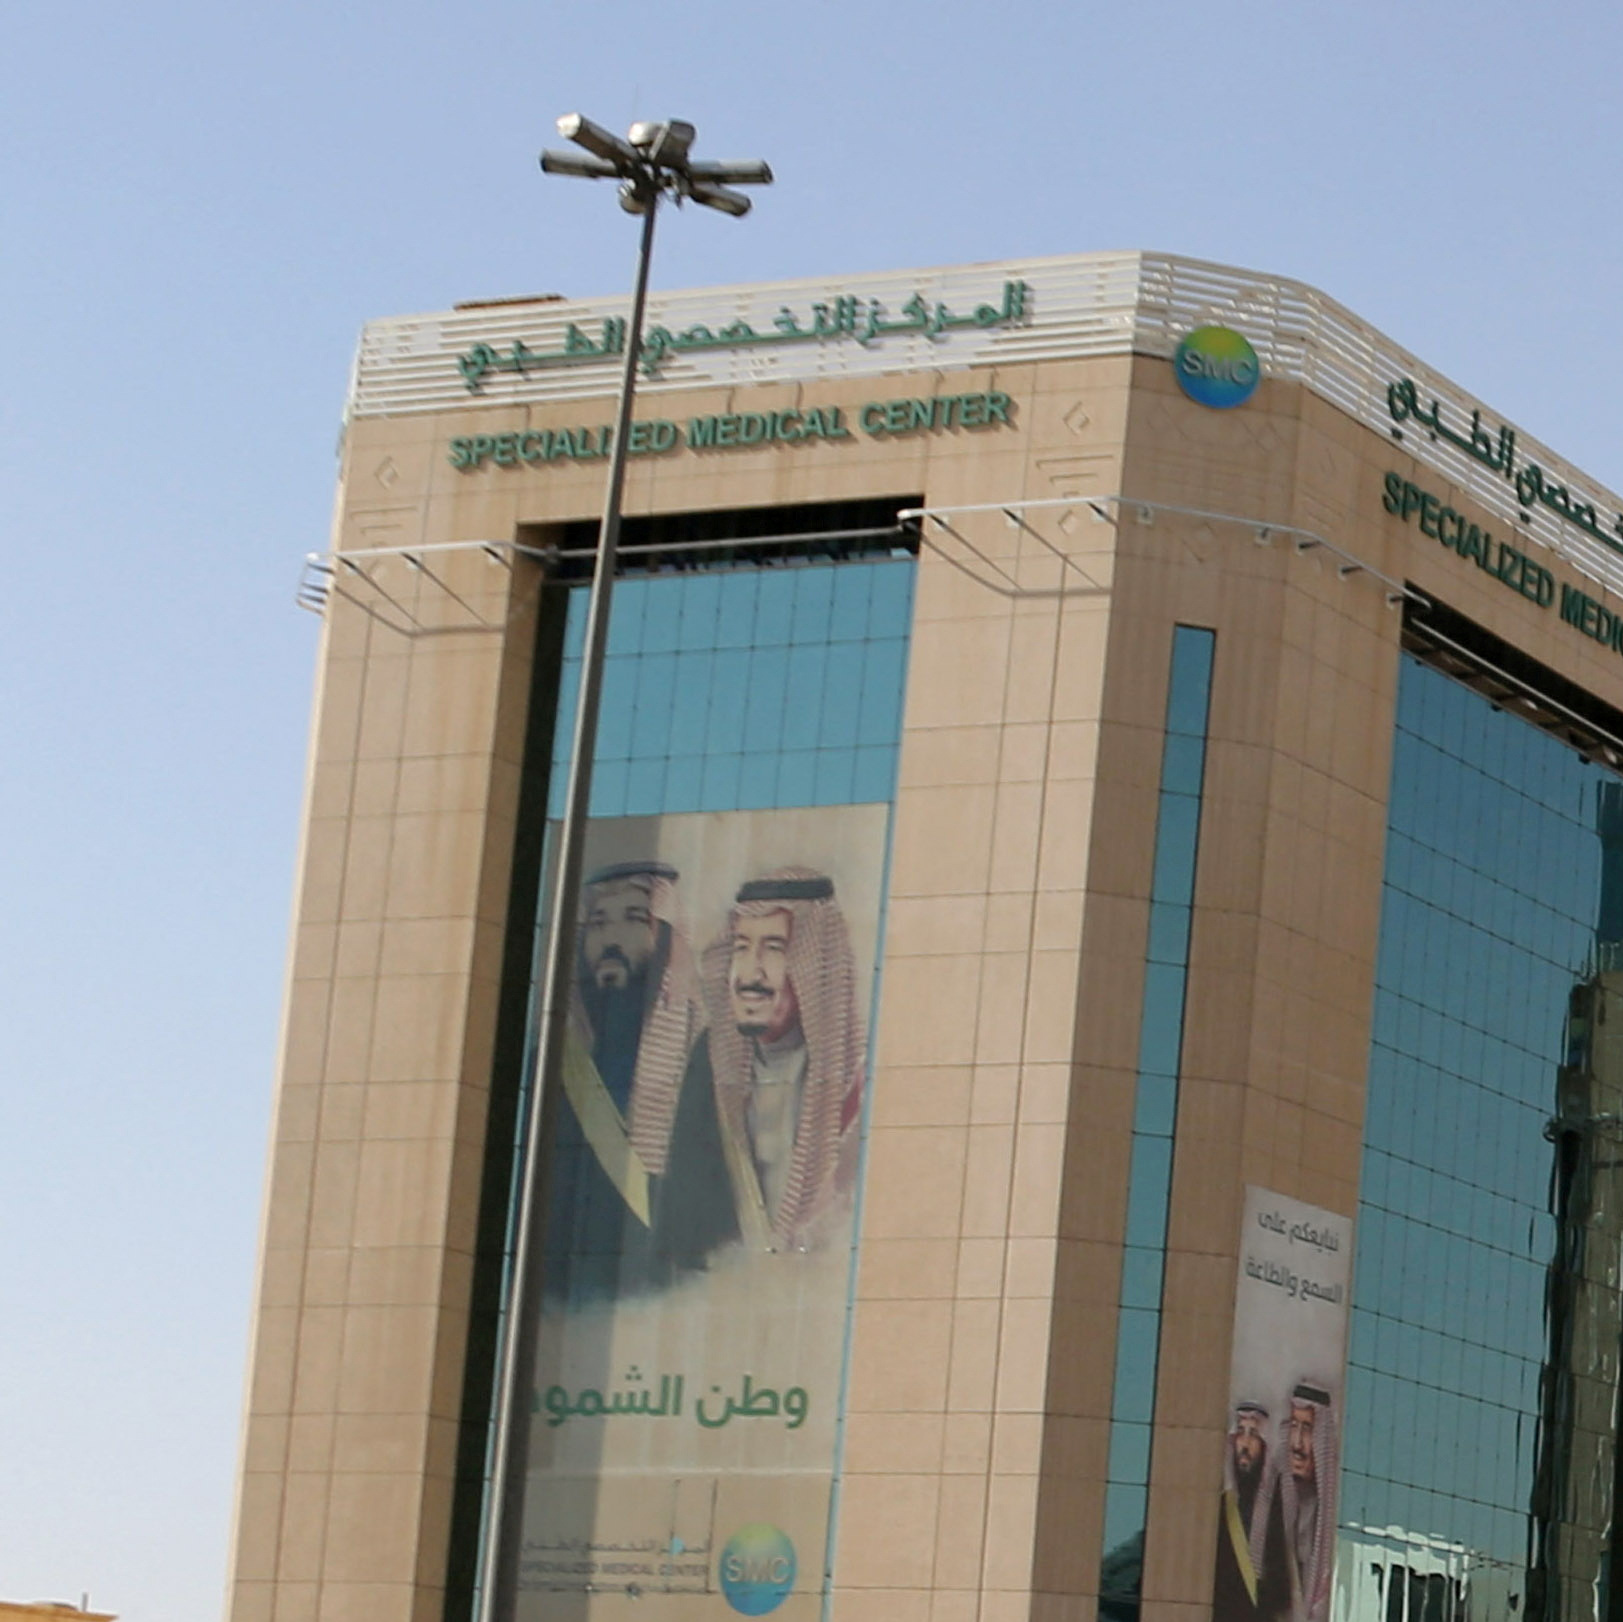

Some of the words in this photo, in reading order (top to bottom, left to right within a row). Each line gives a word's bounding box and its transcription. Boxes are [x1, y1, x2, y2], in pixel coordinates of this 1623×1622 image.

[638, 293, 857, 376] التخصصي
[856, 280, 1029, 346] المركز
[457, 315, 627, 392] الطبي
[1182, 349, 1253, 385] SMC
[448, 420, 678, 470] SPECIALIED
[686, 406, 850, 449] MEDICAL
[858, 391, 1012, 437] CENTER
[1387, 378, 1516, 480] الطبي
[1382, 470, 1556, 610] SPECIALIZED
[529, 1365, 684, 1428] الشمو
[696, 1374, 809, 1429] وطن
[724, 1555, 789, 1585] SMC
